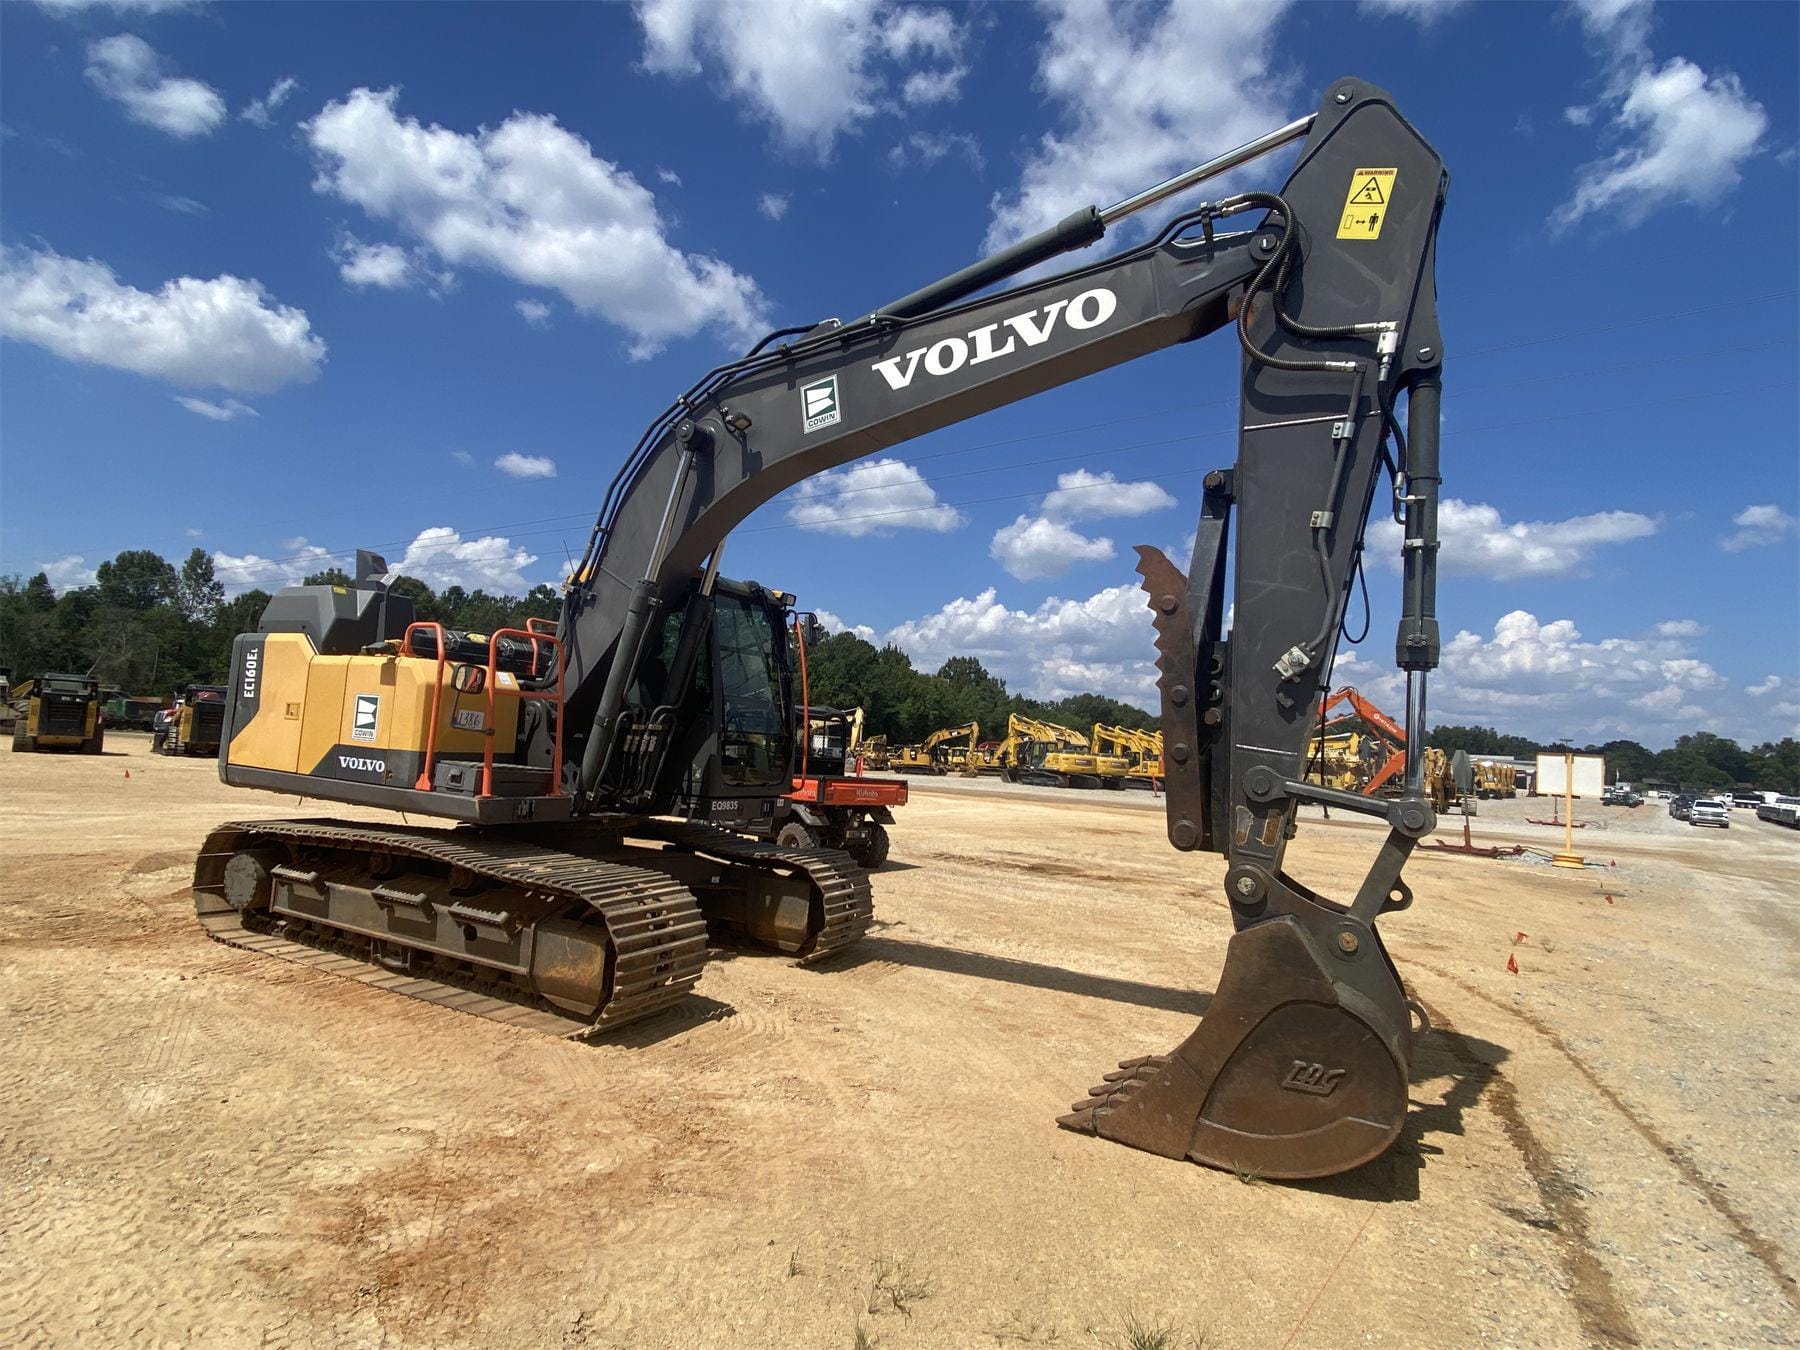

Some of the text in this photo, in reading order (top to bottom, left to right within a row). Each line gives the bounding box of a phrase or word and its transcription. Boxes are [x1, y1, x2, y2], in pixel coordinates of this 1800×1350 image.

[871, 288, 1117, 391] VOLVO
[808, 412, 836, 427] COWIN
[460, 712, 481, 728] 1386
[354, 729, 374, 738] COWIN
[338, 756, 386, 773] VOLVO
[855, 788, 879, 798] Kubota
[711, 800, 738, 811] EQ9835
